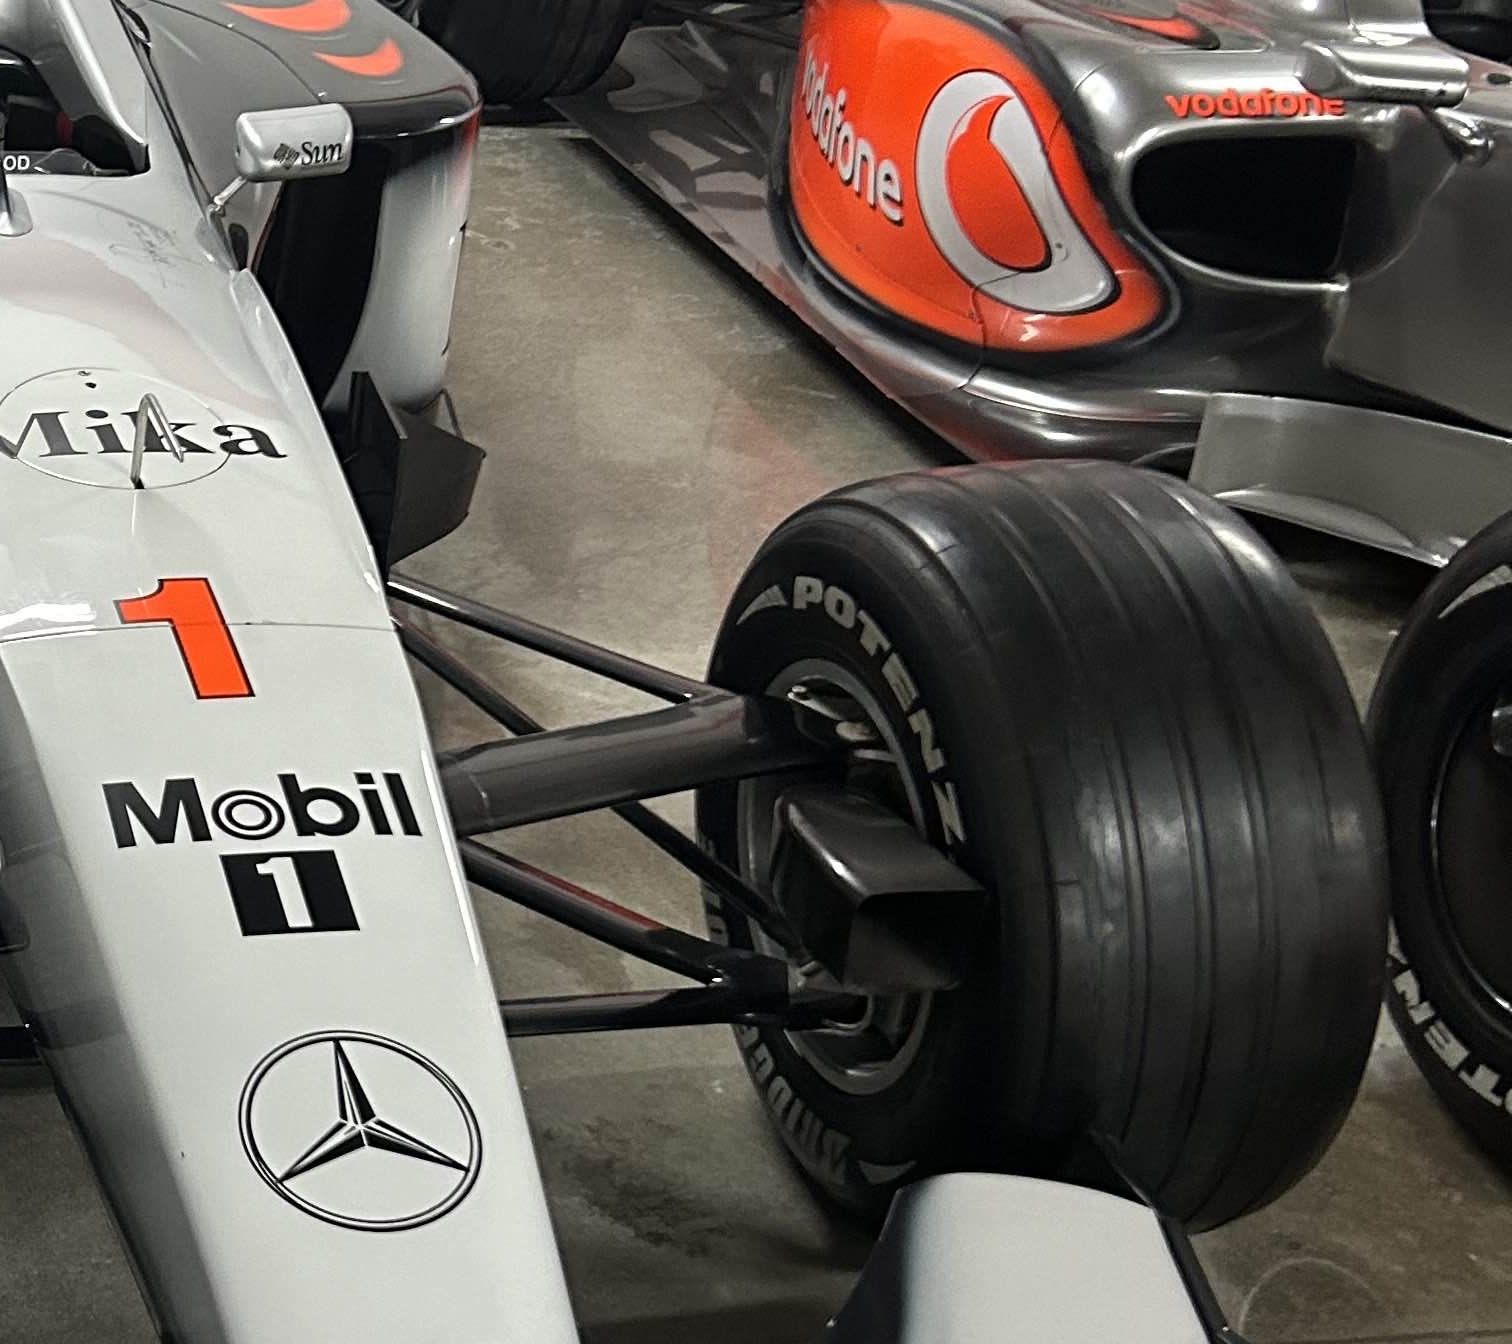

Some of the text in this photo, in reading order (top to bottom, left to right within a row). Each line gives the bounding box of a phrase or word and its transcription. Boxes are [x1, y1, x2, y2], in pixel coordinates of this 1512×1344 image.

[1164, 88, 1346, 118] vodafone
[301, 140, 343, 166] Sun
[113, 576, 256, 700] 1
[793, 576, 968, 860] POTENZ
[102, 772, 423, 848] Mobil
